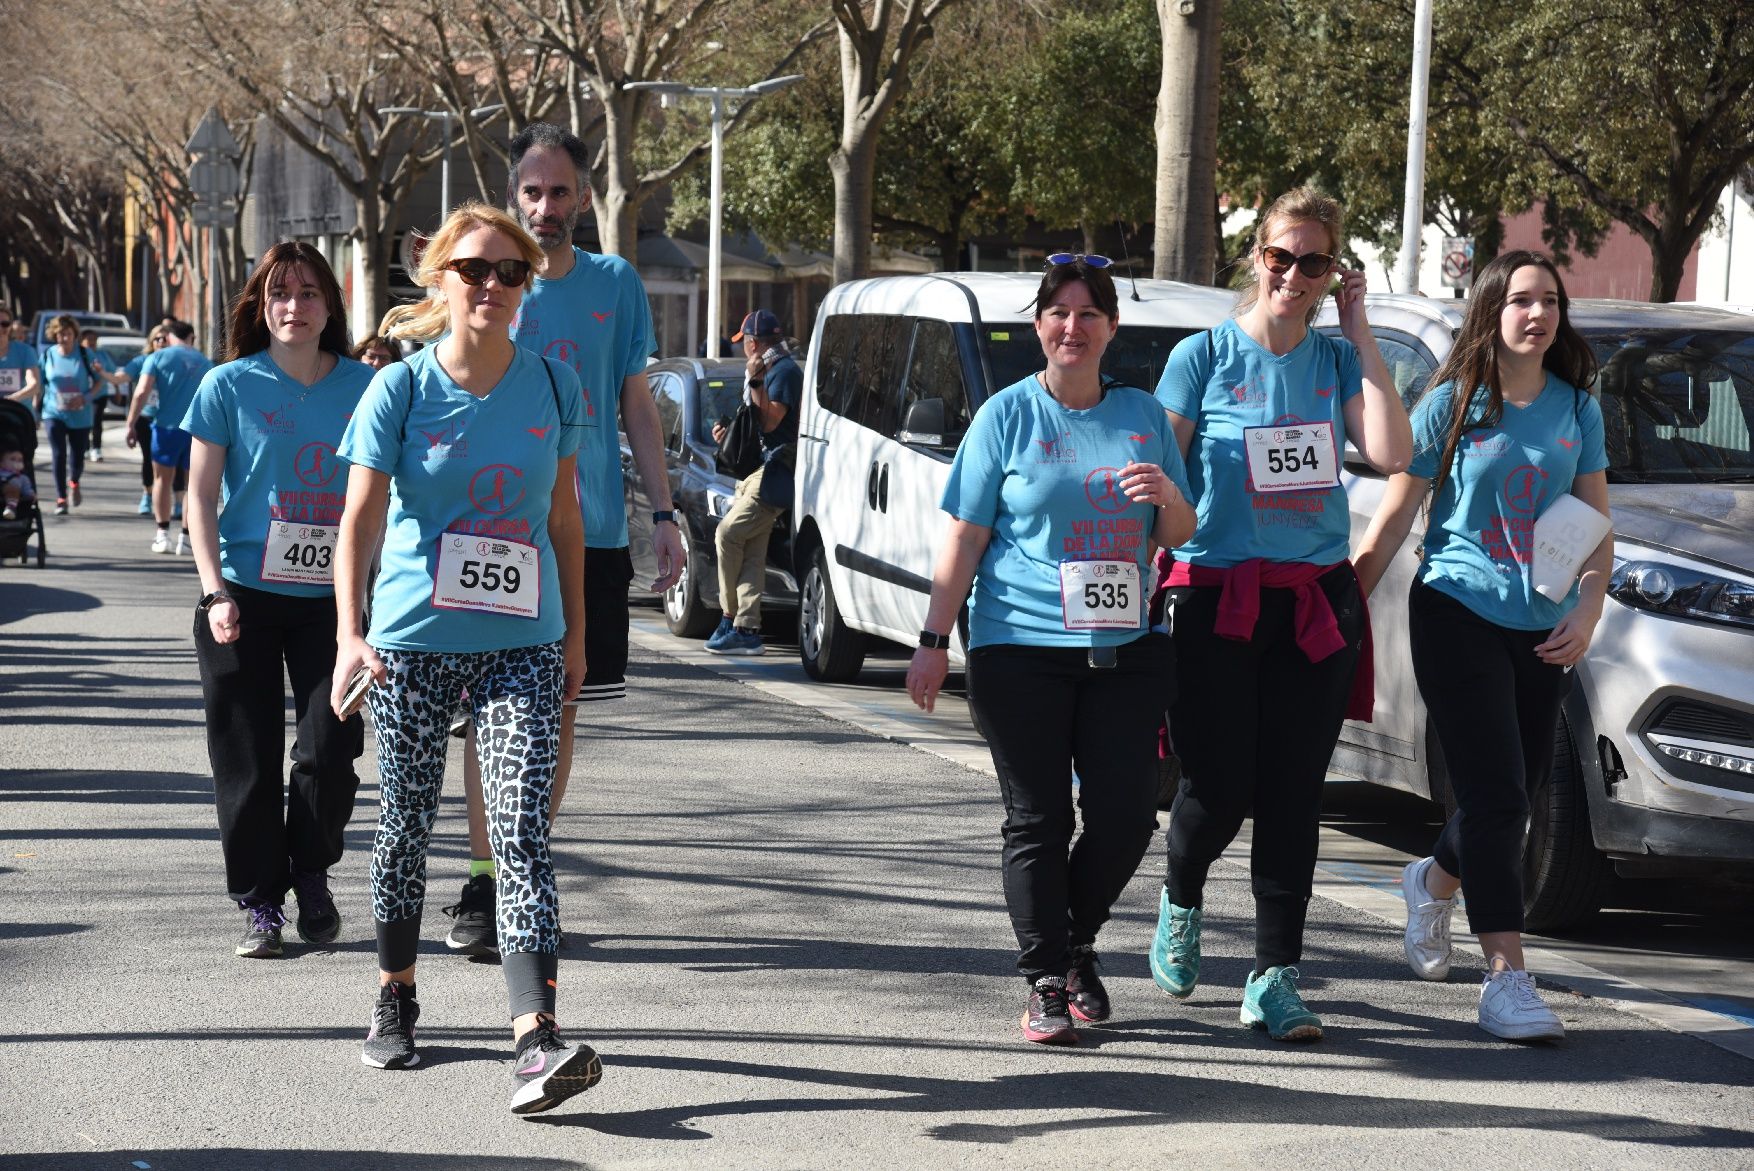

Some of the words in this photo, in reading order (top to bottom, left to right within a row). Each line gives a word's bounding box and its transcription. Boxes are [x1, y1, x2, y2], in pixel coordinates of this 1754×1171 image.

[1268, 445, 1319, 474] 554
[1252, 495, 1325, 513] MANRESA
[474, 518, 531, 536] CURSA
[1072, 519, 1094, 535] VII
[1063, 536, 1087, 553] DE
[1089, 535, 1111, 551] LA
[283, 543, 332, 569] 403
[459, 560, 521, 594] 559
[1084, 583, 1129, 609] 535
